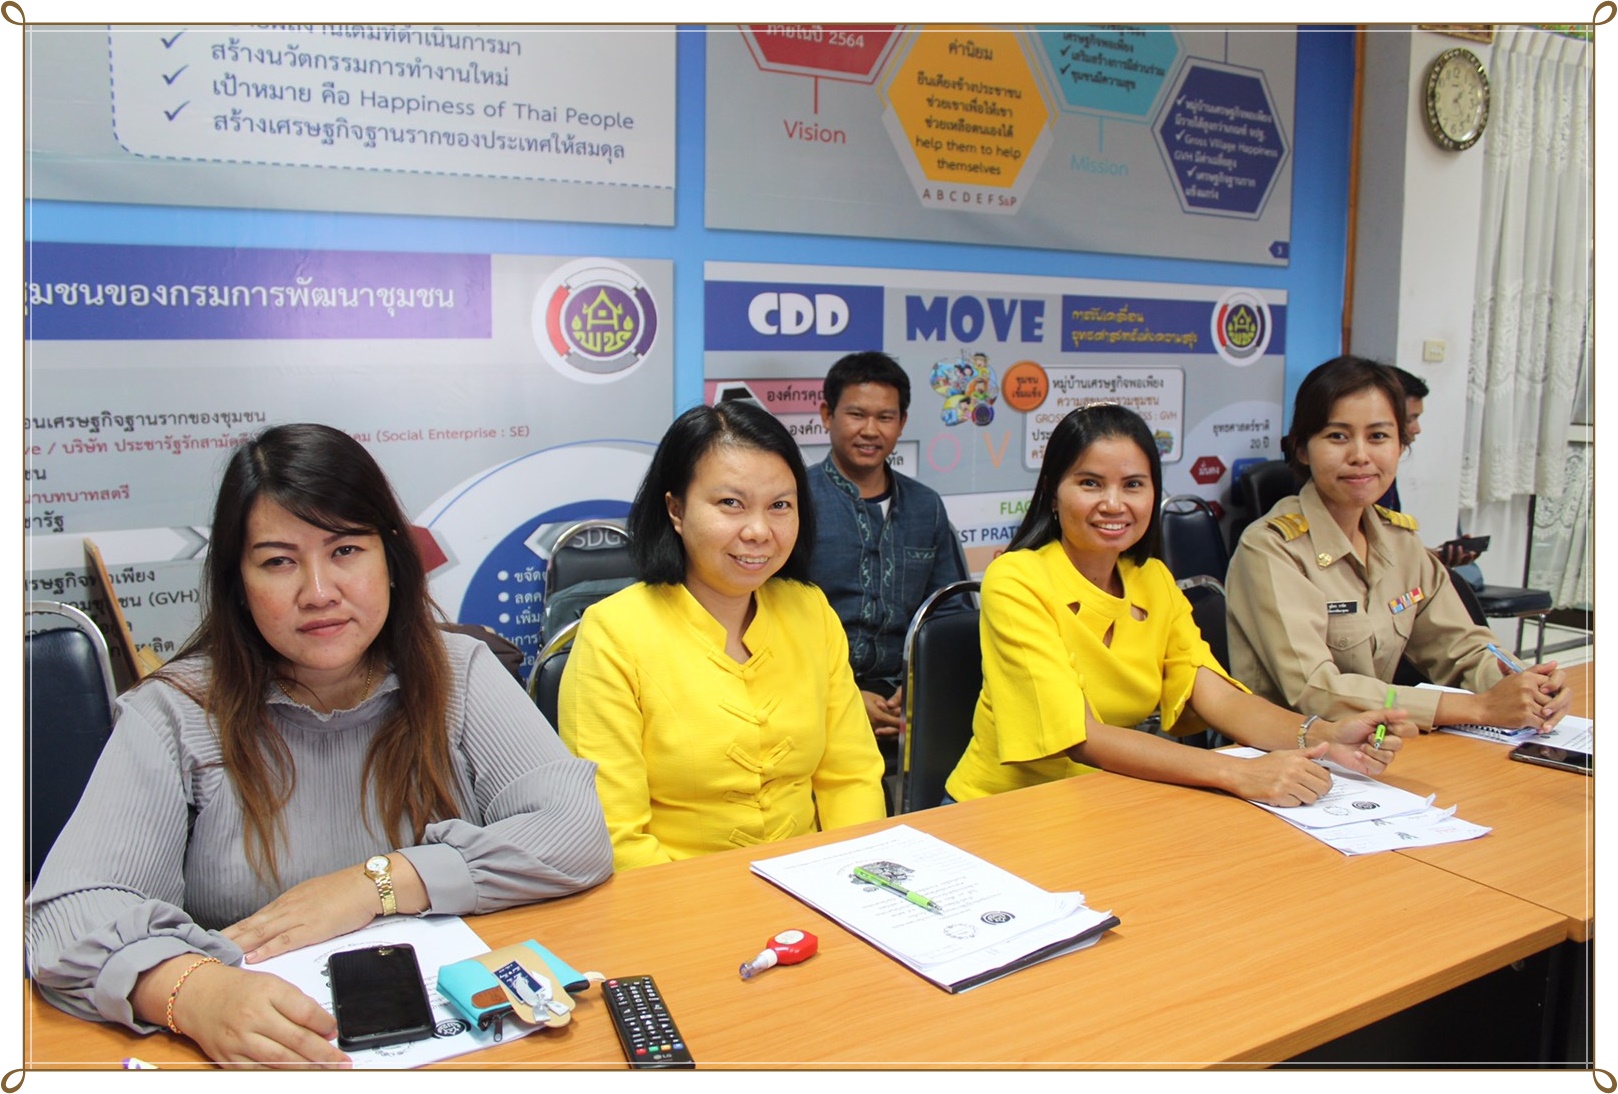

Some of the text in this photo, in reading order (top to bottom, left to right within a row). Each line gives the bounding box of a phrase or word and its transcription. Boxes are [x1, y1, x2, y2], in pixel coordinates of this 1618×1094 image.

[828, 31, 865, 49] 2564
[948, 38, 994, 61] ค่านิยม
[210, 36, 510, 87] สร้างนวัตกรรมการทำงานใหม่
[212, 72, 635, 131] เป้าหมาย คือ Happiness of Thai People
[212, 107, 626, 163] สร้างเศรษฐกิจฐานรากของประเทศให้สมดุล
[783, 119, 847, 145] Vision
[915, 135, 1022, 162] help them to help
[937, 156, 1002, 176] themselves
[1070, 154, 1130, 177] Mission
[923, 188, 931, 200] A
[937, 189, 944, 200] B
[949, 190, 957, 202] C
[963, 191, 970, 203] D
[976, 193, 983, 204] E
[988, 194, 994, 205] F
[748, 291, 850, 337] CDD
[905, 294, 1046, 344] MOVE
[376, 428, 424, 444] (Social
[428, 428, 497, 443] Enterprise
[509, 424, 530, 439] SE)
[1249, 438, 1261, 450] 20
[61, 438, 109, 455] บริษัท
[983, 430, 1013, 470] V
[149, 588, 200, 607] (GVH)
